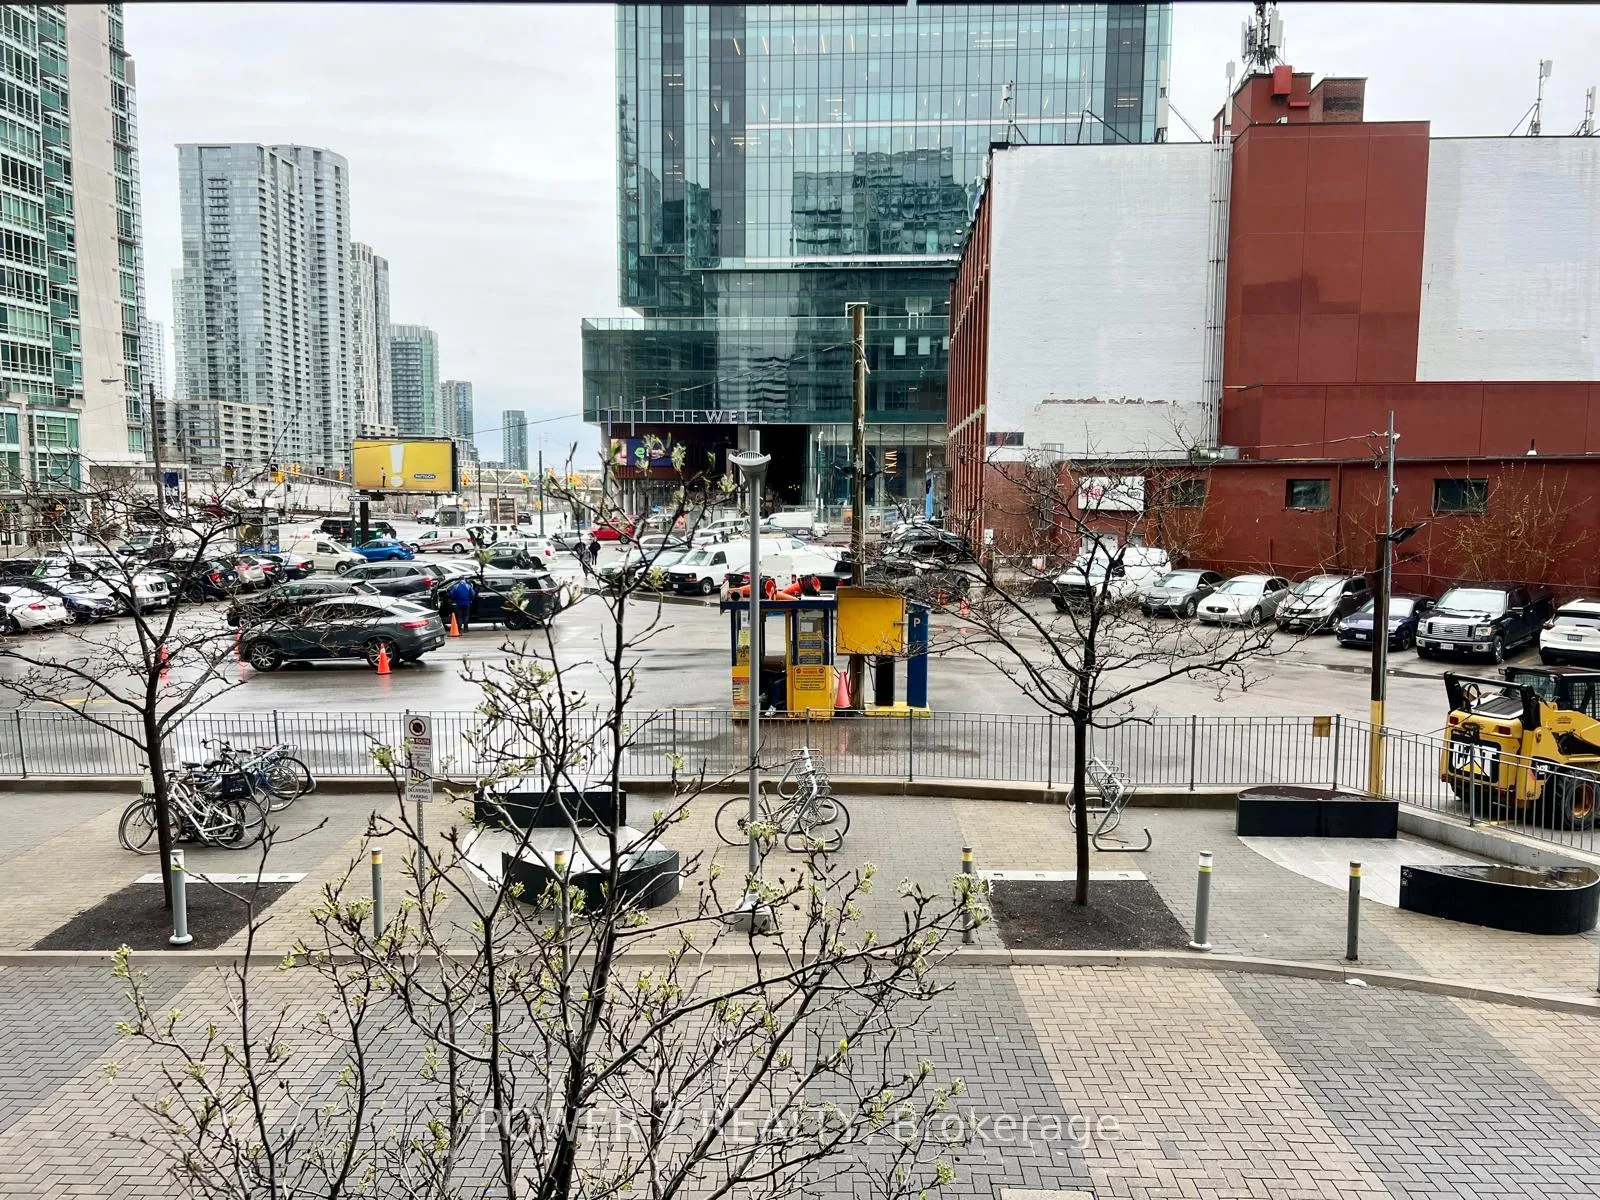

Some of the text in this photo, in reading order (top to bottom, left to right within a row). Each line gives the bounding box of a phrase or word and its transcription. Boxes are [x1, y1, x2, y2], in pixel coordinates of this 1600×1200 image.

[661, 409, 768, 424] THE WELL
[913, 617, 921, 628] P
[1452, 742, 1497, 777] CAT
[411, 769, 426, 779] NO
